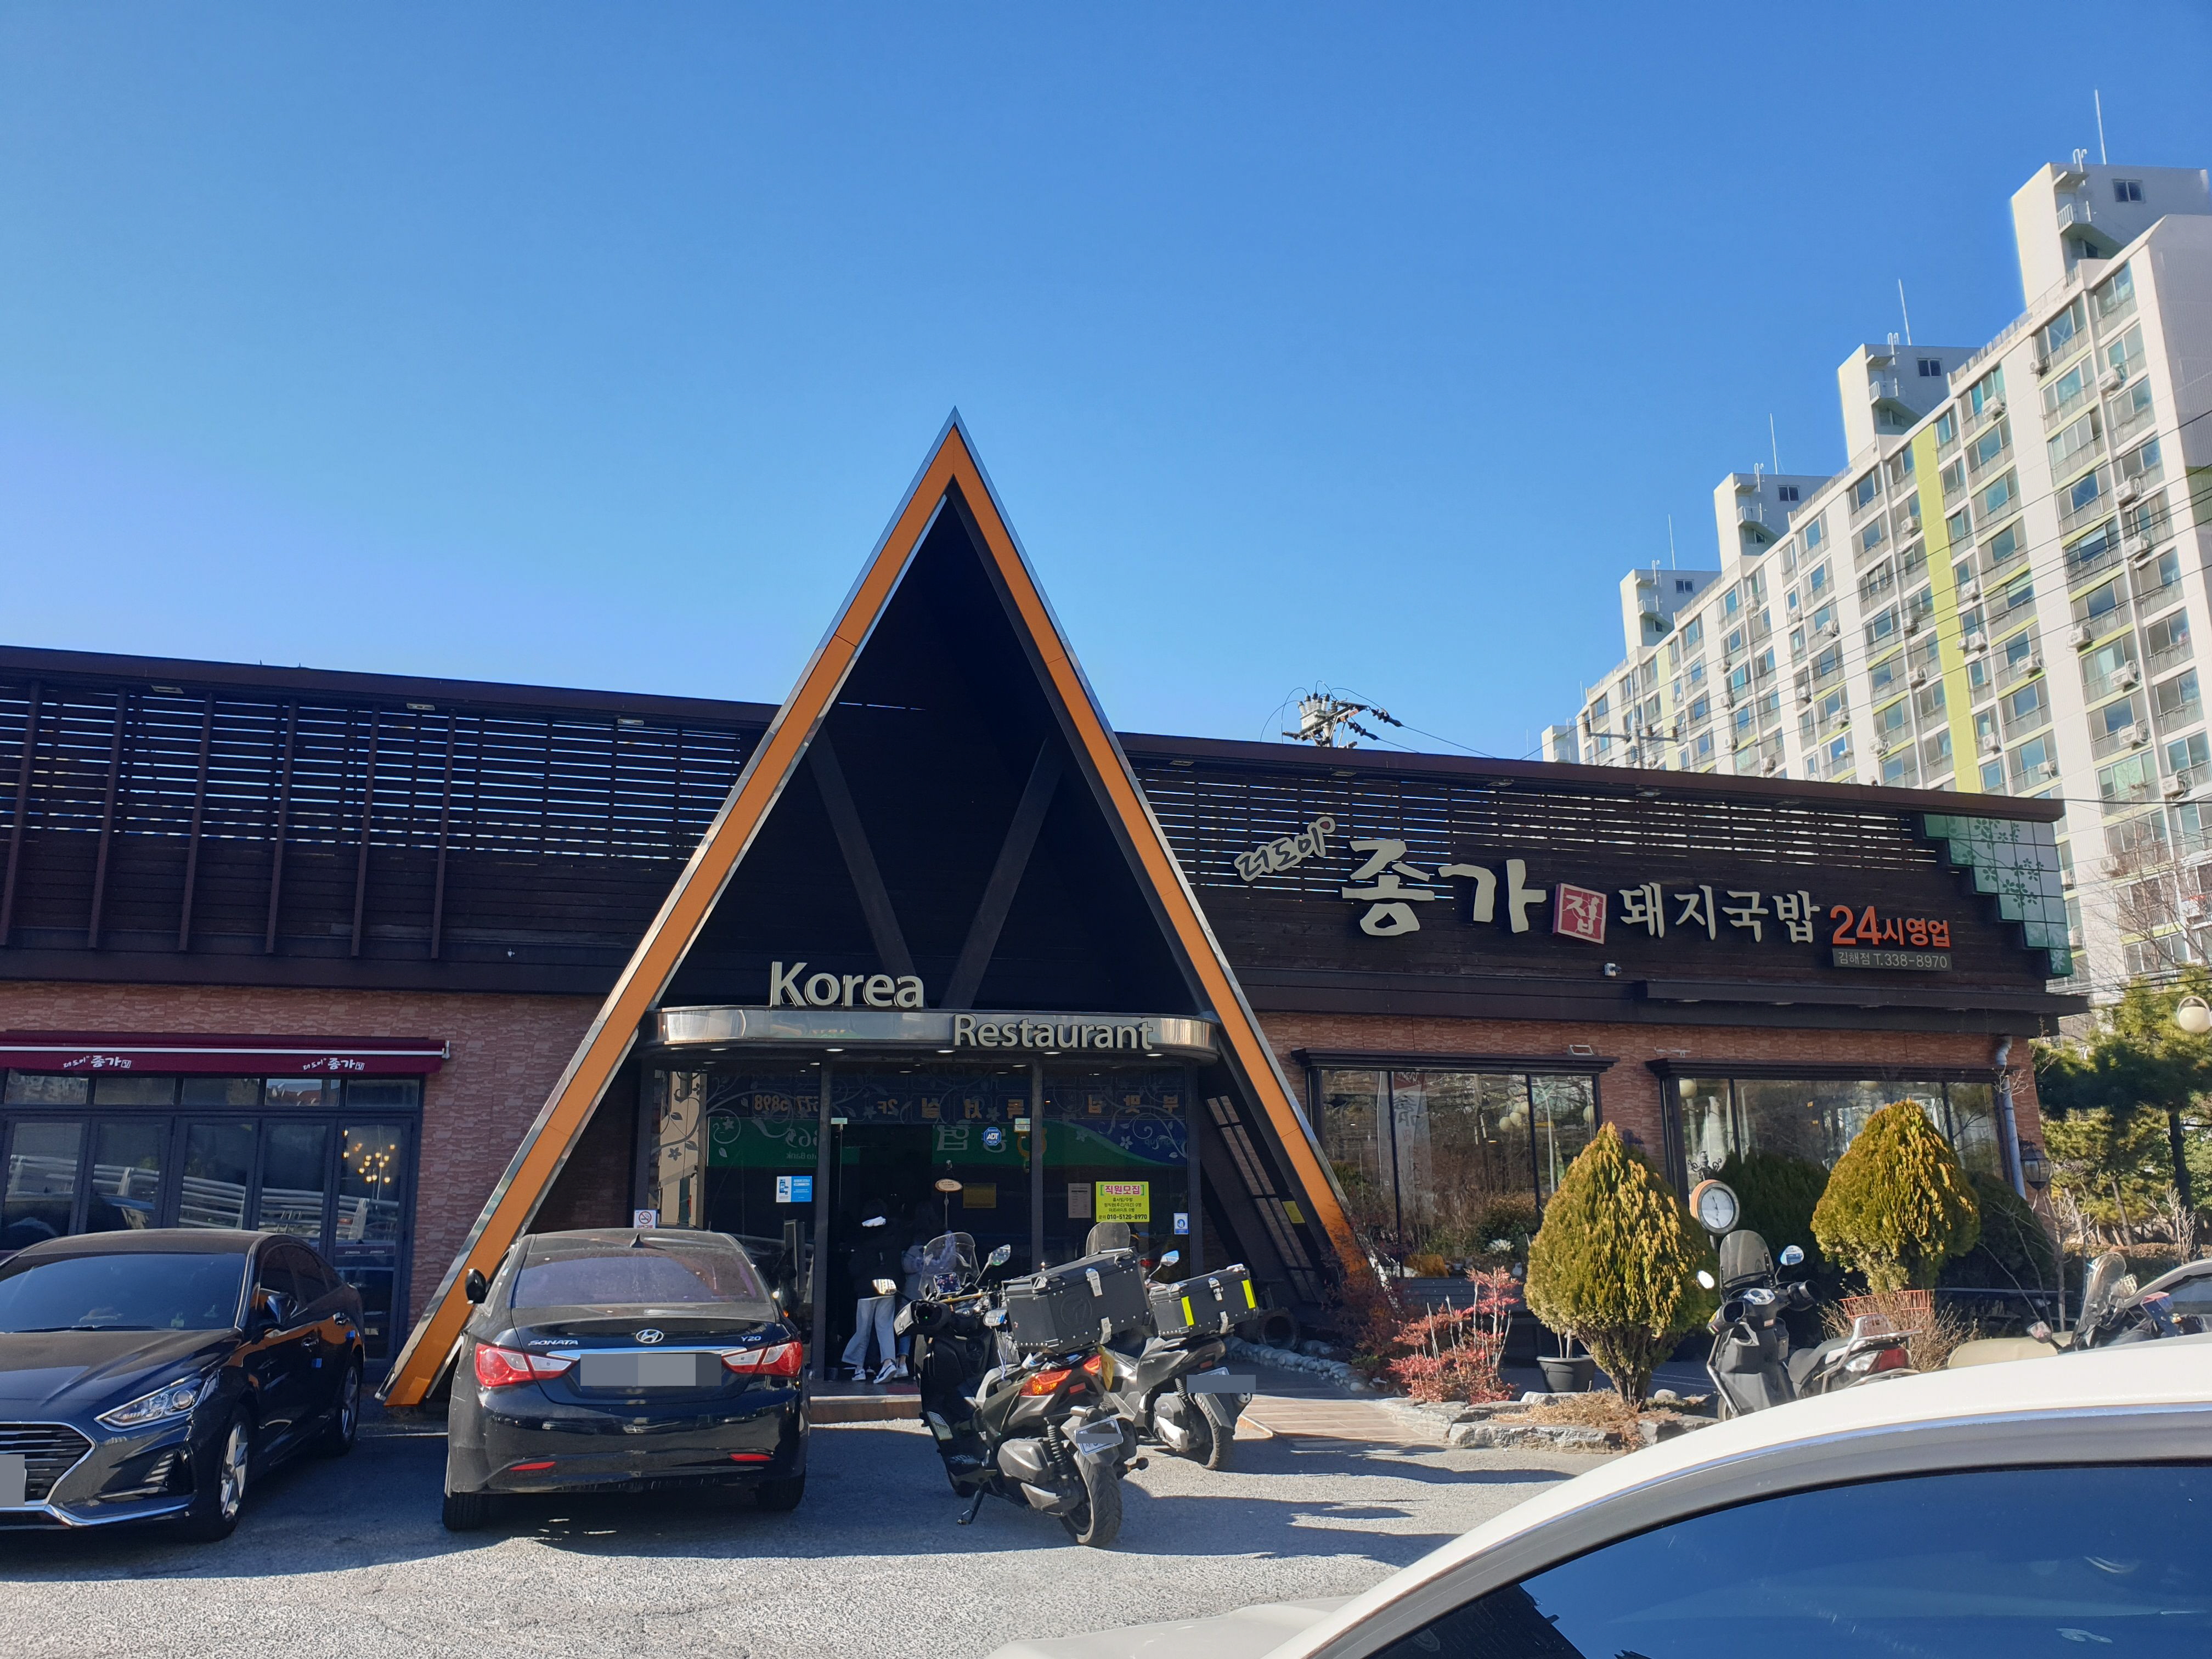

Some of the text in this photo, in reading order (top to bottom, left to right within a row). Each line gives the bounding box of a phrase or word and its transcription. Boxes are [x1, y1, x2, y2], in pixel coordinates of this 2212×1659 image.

[1618, 882, 1820, 944] 돼지국밥
[1838, 952, 1870, 966] 김해점
[771, 961, 924, 1007] Korea
[954, 1014, 1153, 1050] Restaurant
